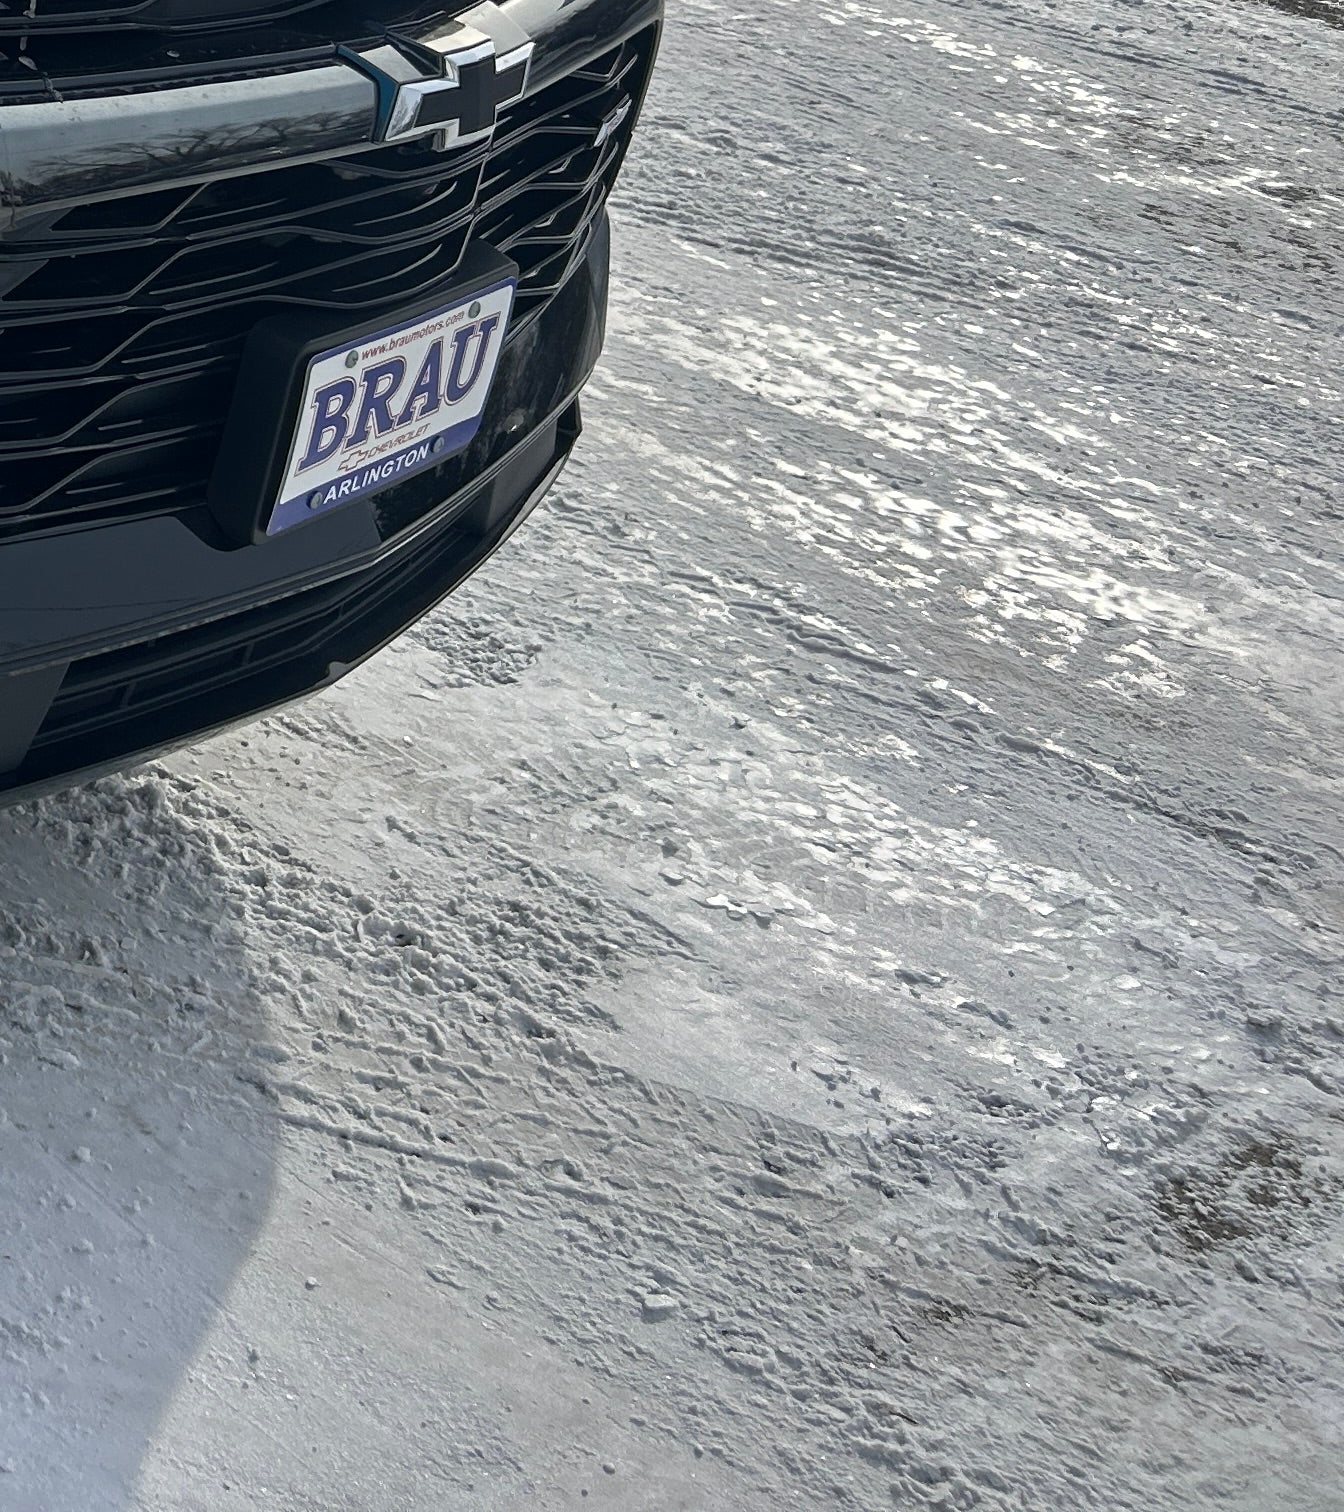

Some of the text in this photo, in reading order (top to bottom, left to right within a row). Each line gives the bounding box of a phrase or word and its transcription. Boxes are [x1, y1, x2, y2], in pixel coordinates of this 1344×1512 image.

[361, 311, 464, 360] www.braumotors.com
[294, 312, 501, 476] BRAU
[323, 443, 429, 503] ARLINGTON
